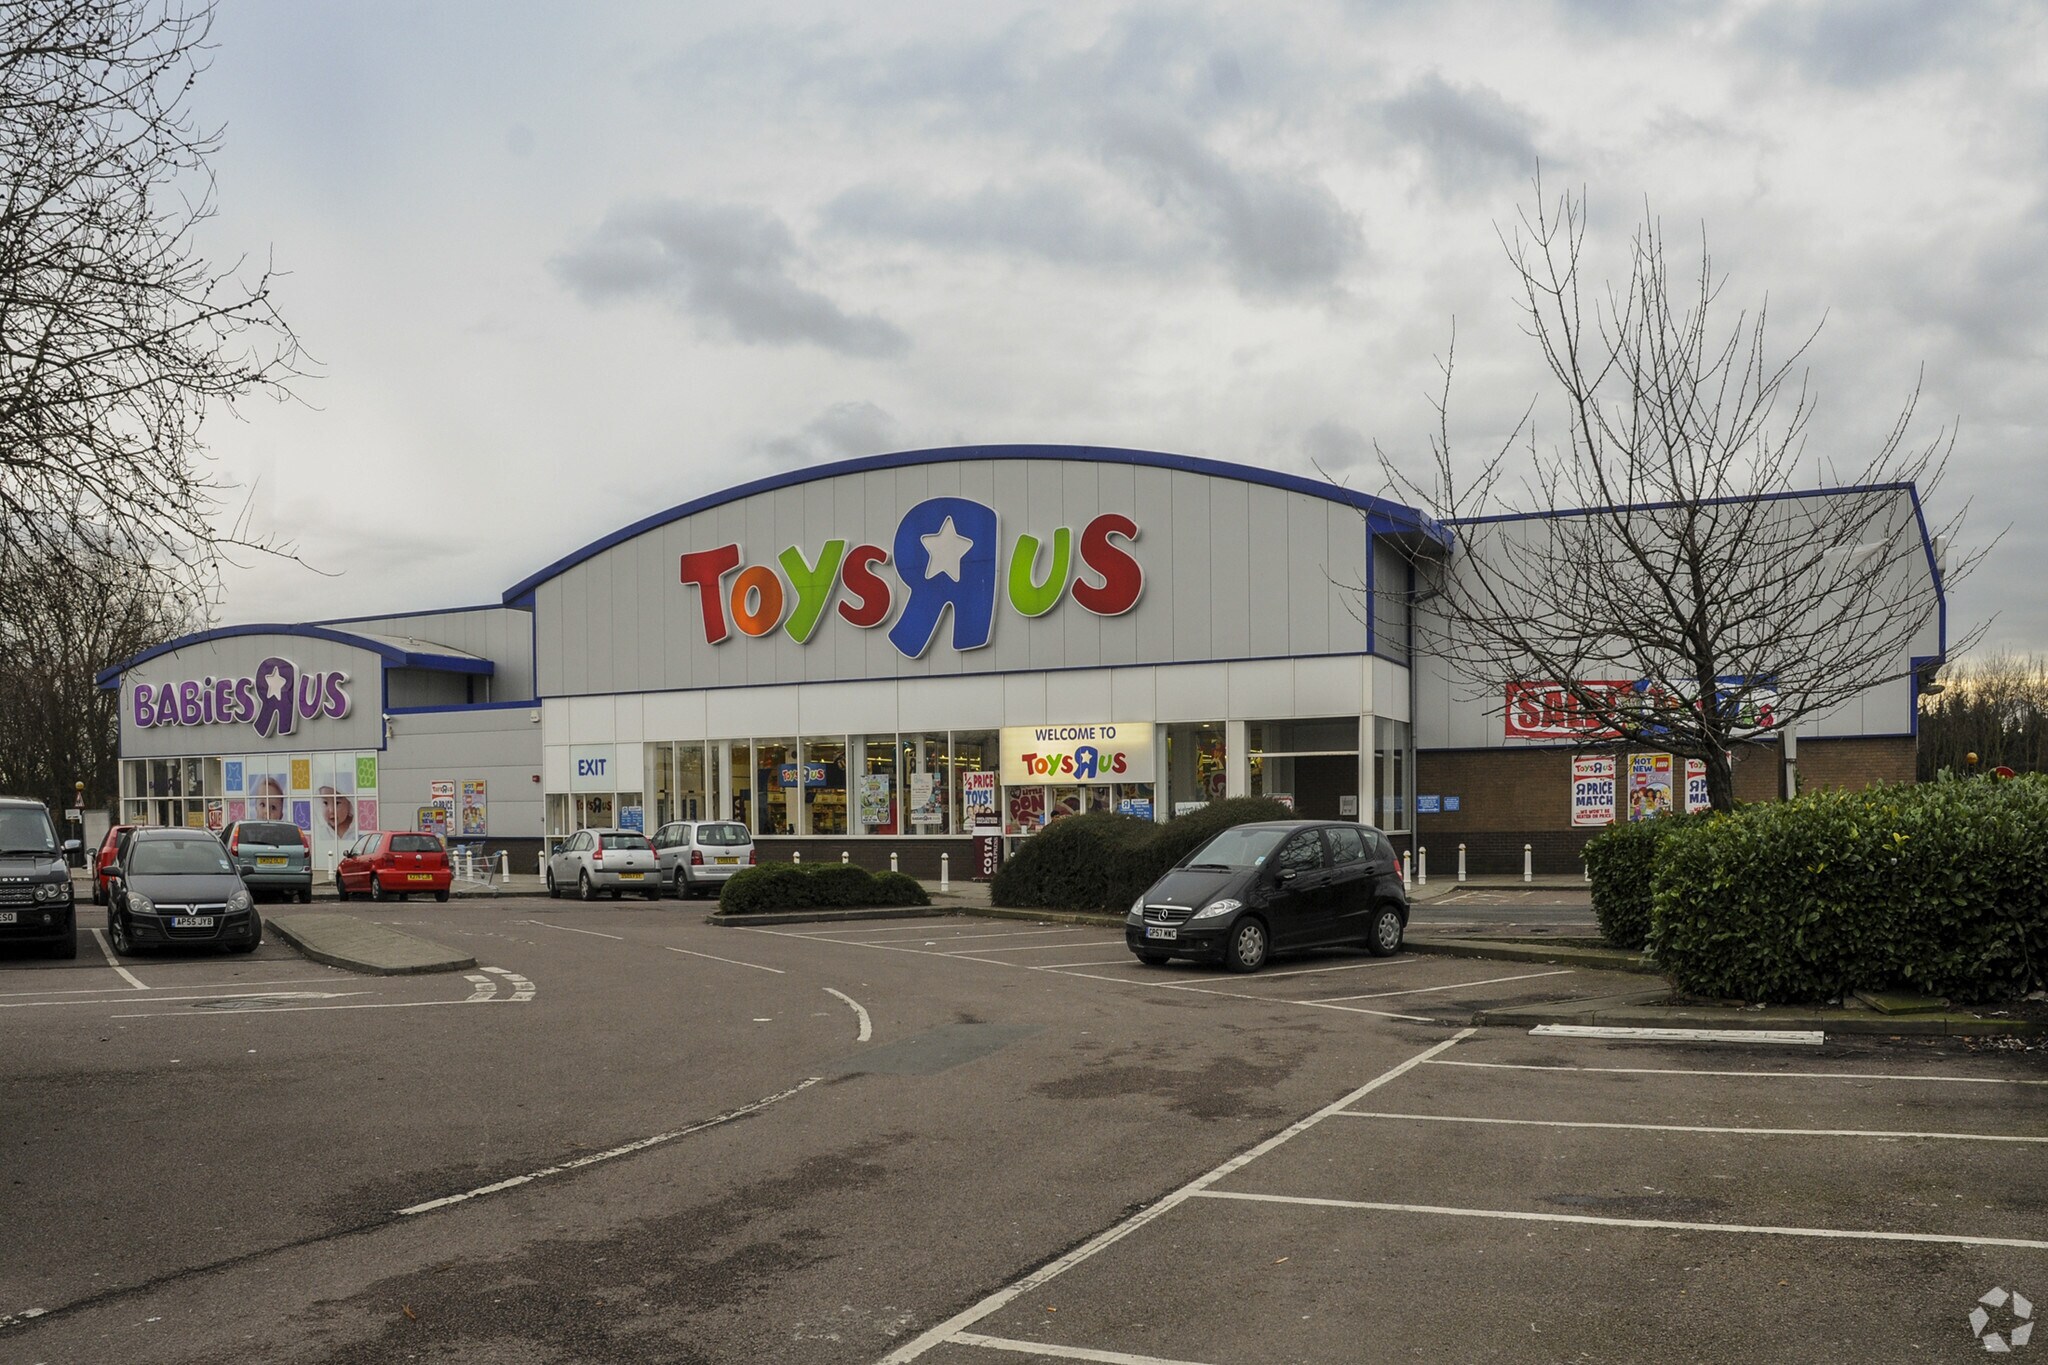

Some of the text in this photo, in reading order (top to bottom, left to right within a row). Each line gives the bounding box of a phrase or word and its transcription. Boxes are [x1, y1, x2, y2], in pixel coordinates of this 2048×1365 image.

[1035, 726, 1117, 741] WELCOME TO
[578, 758, 607, 776] EXIT
[1634, 757, 1652, 765] HOT
[1632, 765, 1653, 773] NEW
[973, 774, 993, 788] PRICE
[1587, 781, 1613, 795] PRICE
[965, 789, 993, 805] TOYS!
[1576, 795, 1613, 806] MATCH
[983, 836, 993, 875] COSTA
[176, 917, 213, 926] AP55 JYB
